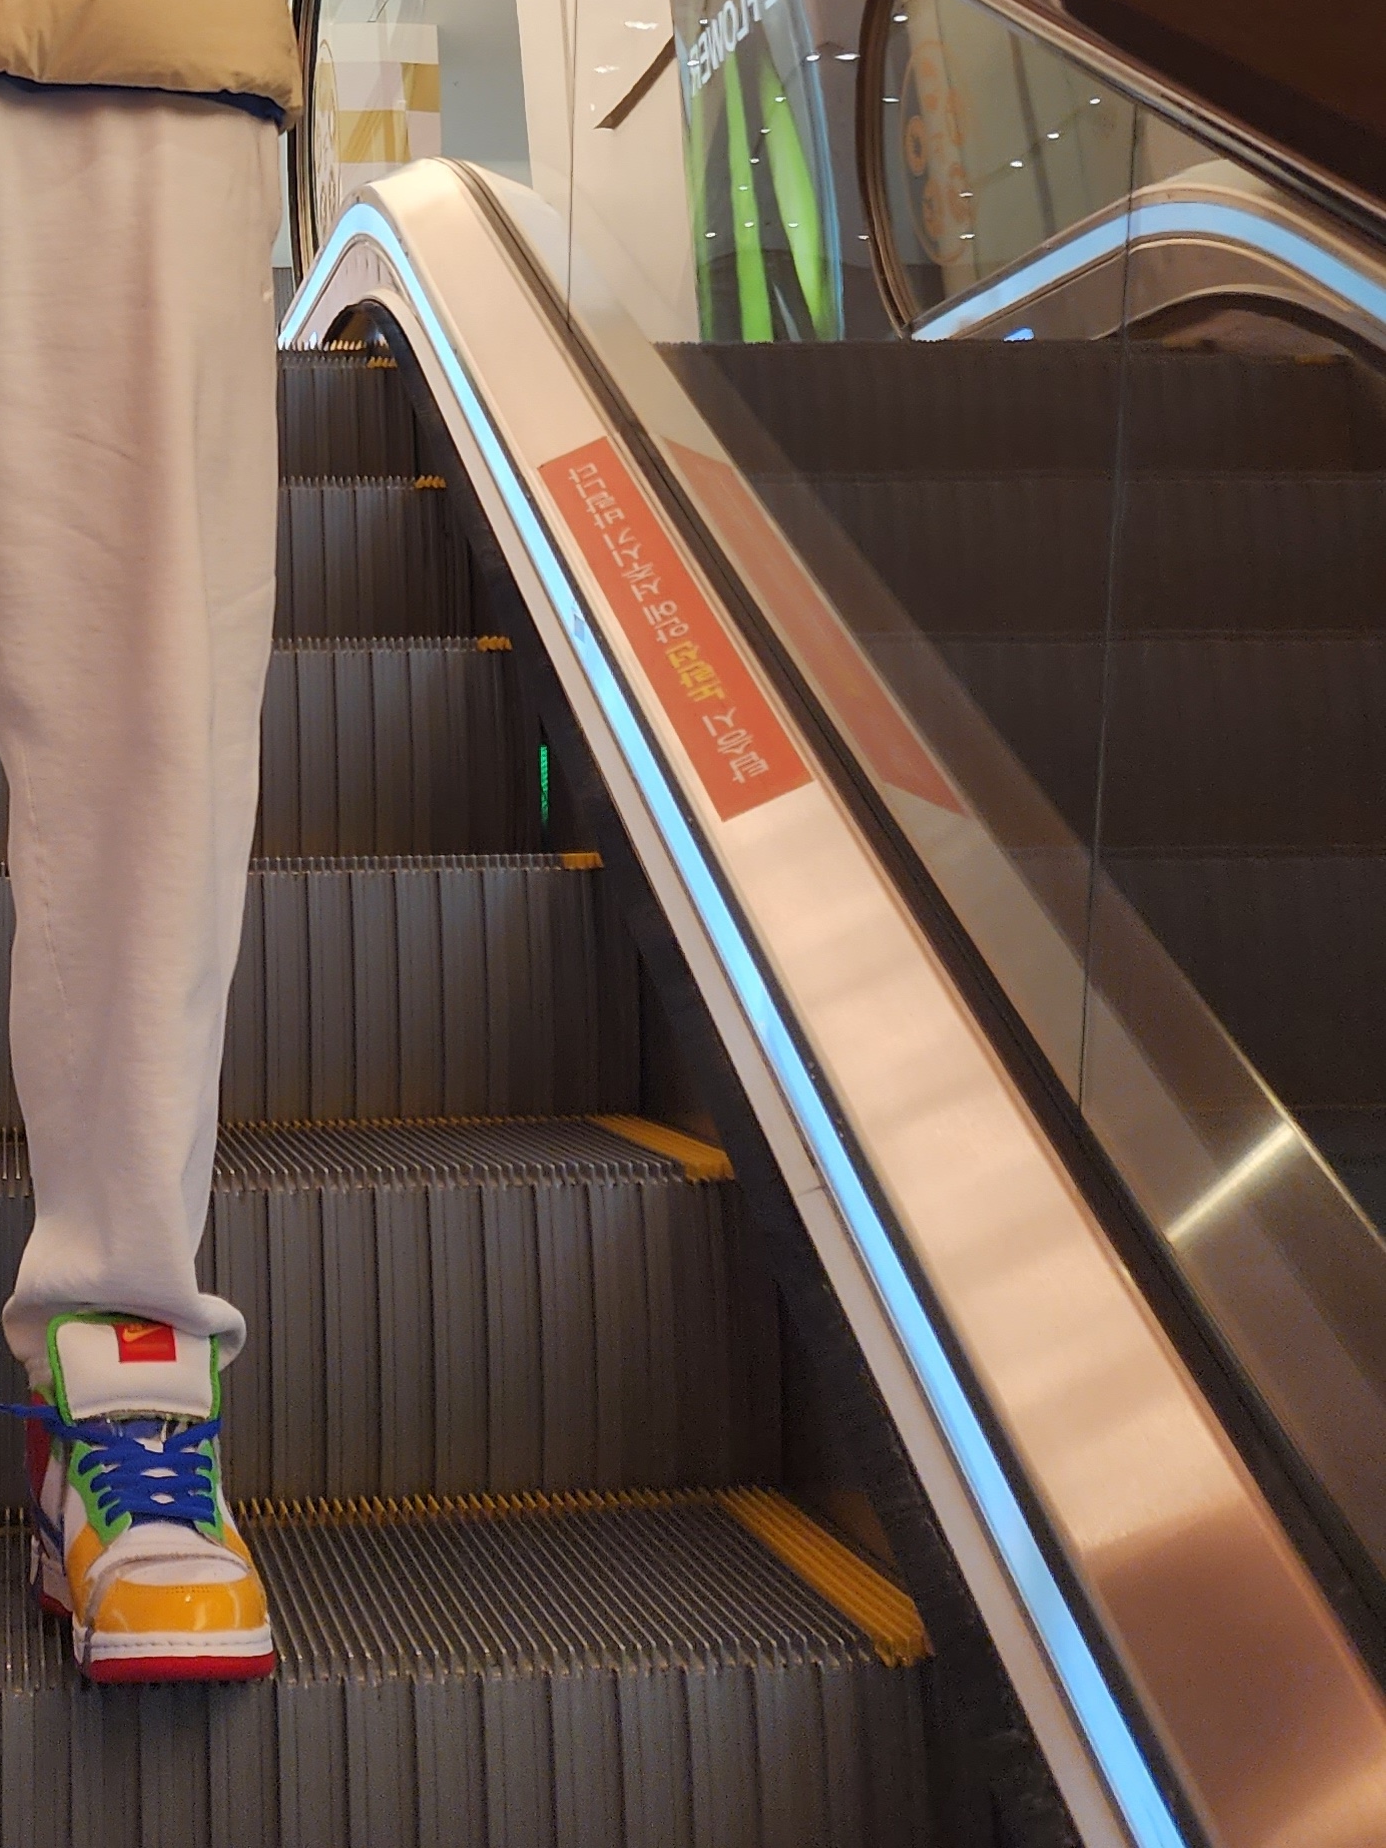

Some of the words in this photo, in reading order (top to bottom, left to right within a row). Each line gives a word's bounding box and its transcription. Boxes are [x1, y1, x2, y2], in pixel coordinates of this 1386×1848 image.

[568, 462, 625, 530] 바랍니다
[642, 600, 689, 644] 안에
[665, 640, 726, 703] 노란선
